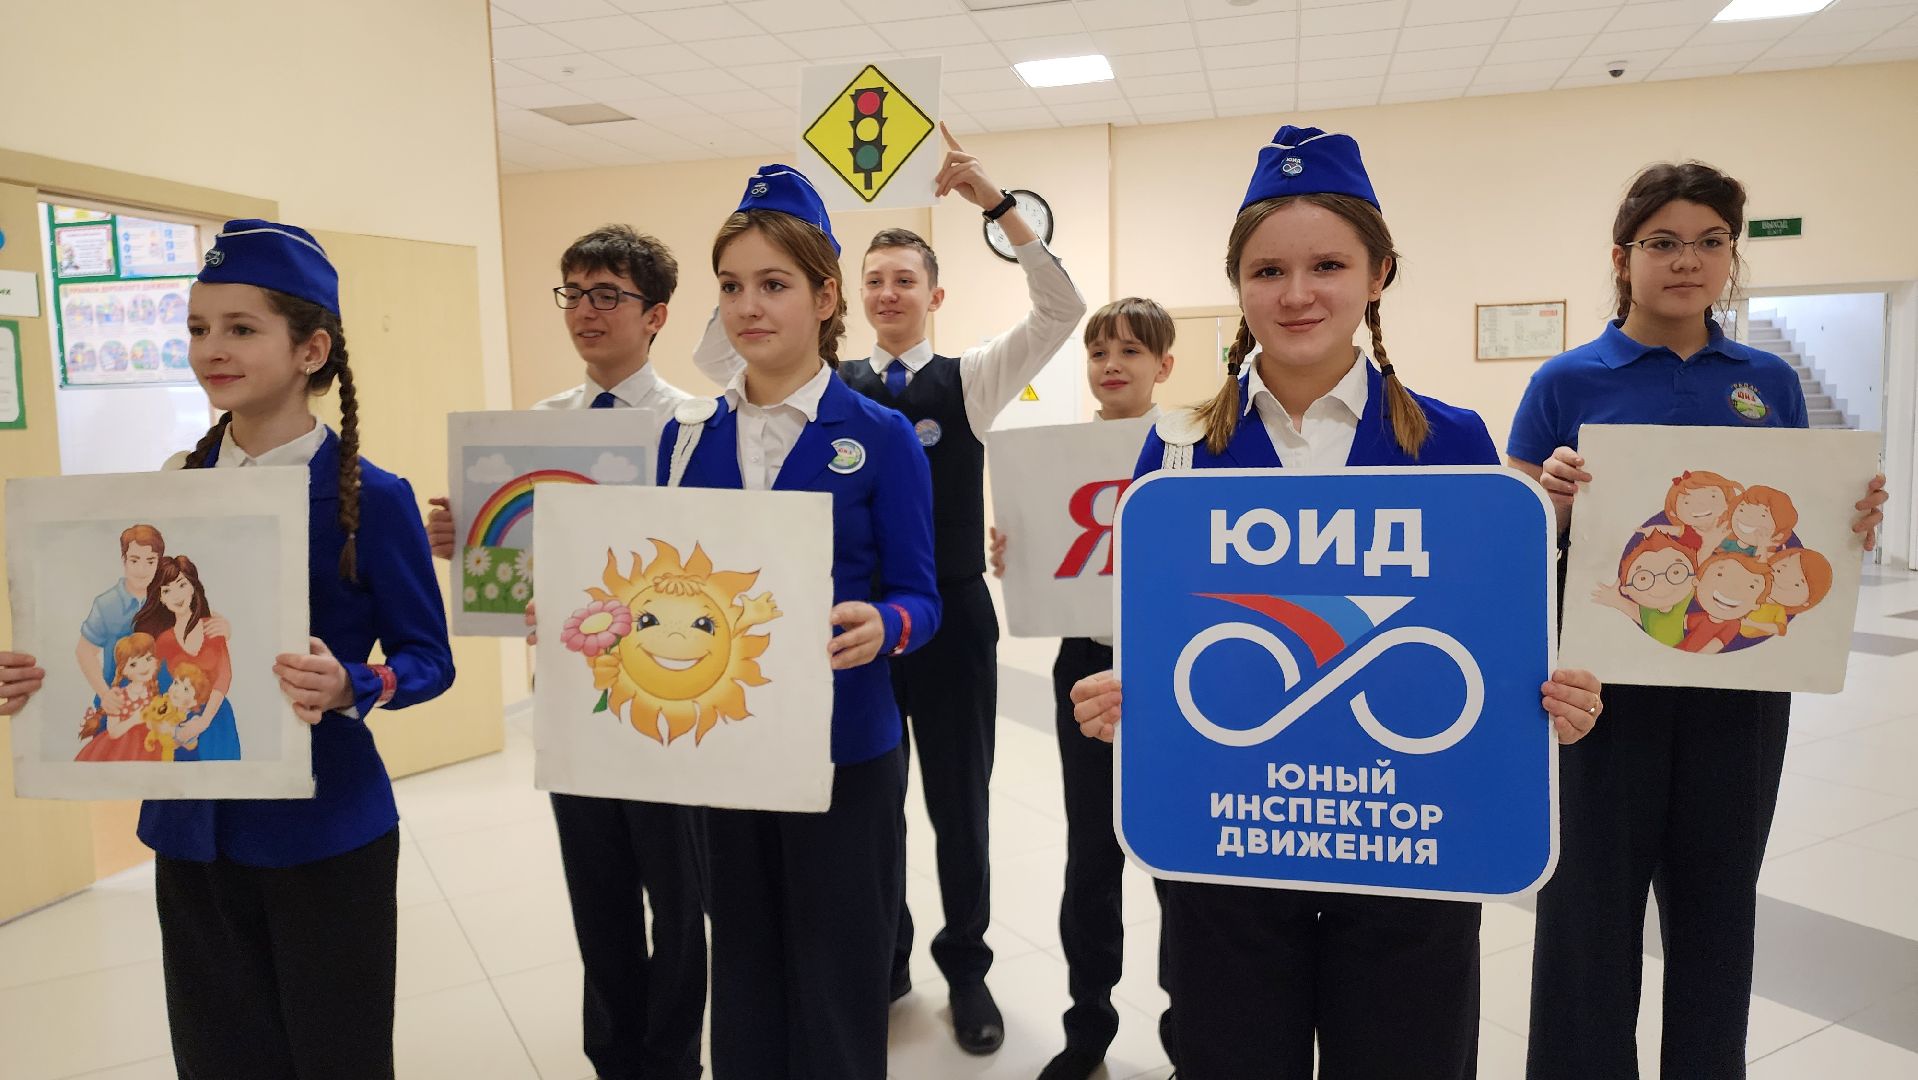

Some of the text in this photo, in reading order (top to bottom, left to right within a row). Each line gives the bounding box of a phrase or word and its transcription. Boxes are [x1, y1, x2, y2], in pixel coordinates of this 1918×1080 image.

[1761, 219, 1788, 230] ВЫХОД
[1210, 508, 1430, 577] ЮИД
[1267, 759, 1396, 795] ЮНЫЙ
[1210, 792, 1444, 831] ИНСПЕКТОР
[1216, 826, 1439, 866] ДВИЖЕНИЯ
